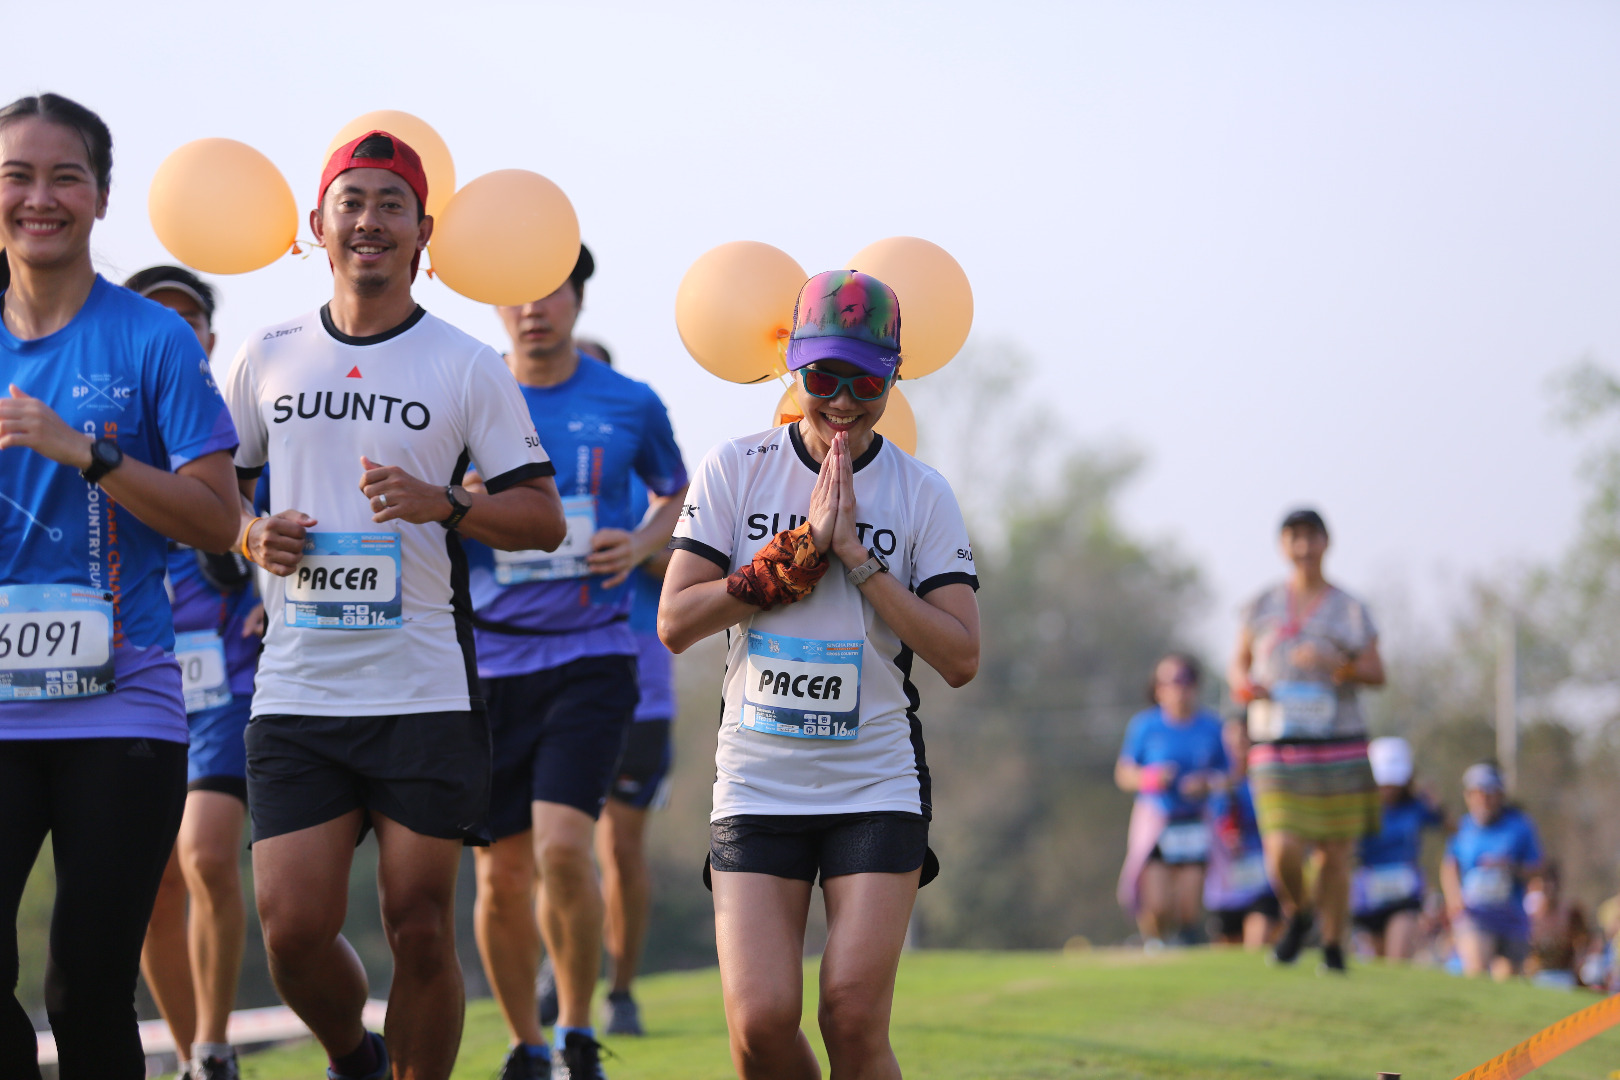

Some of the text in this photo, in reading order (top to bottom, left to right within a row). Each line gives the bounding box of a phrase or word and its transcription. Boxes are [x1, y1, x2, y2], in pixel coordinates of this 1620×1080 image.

[72, 386, 131, 399] SP XC
[273, 391, 431, 431] SUUNTO
[747, 513, 897, 556] SUTO
[297, 566, 378, 590] PACER
[371, 611, 386, 626] 16
[81, 677, 99, 694] 16
[758, 669, 842, 700] PACER
[833, 721, 847, 737] 16
